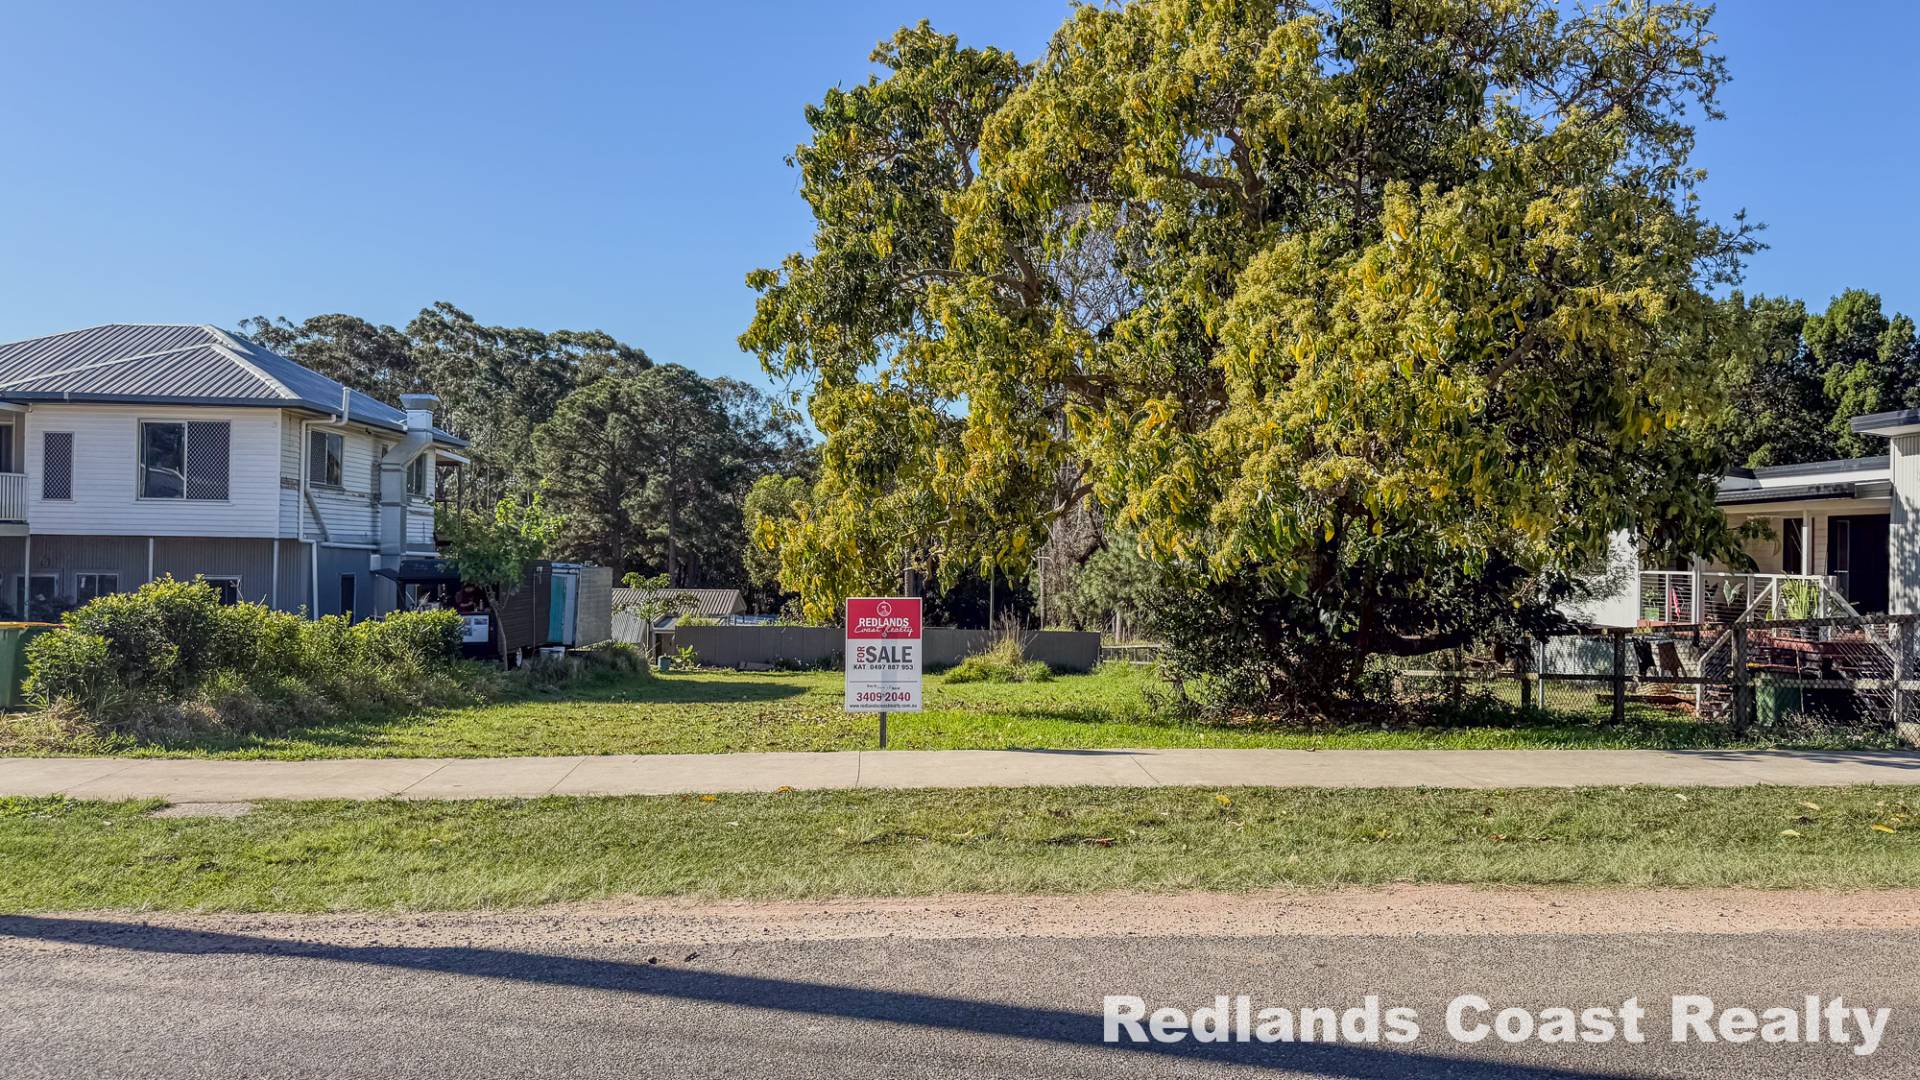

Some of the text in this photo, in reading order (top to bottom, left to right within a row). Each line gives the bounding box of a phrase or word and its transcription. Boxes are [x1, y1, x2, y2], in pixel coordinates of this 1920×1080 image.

[859, 617, 910, 627] REDLANDS
[854, 625, 881, 634] Coast
[857, 646, 866, 663] FOR
[866, 645, 913, 663] SALE
[856, 692, 911, 702] 3409 2040
